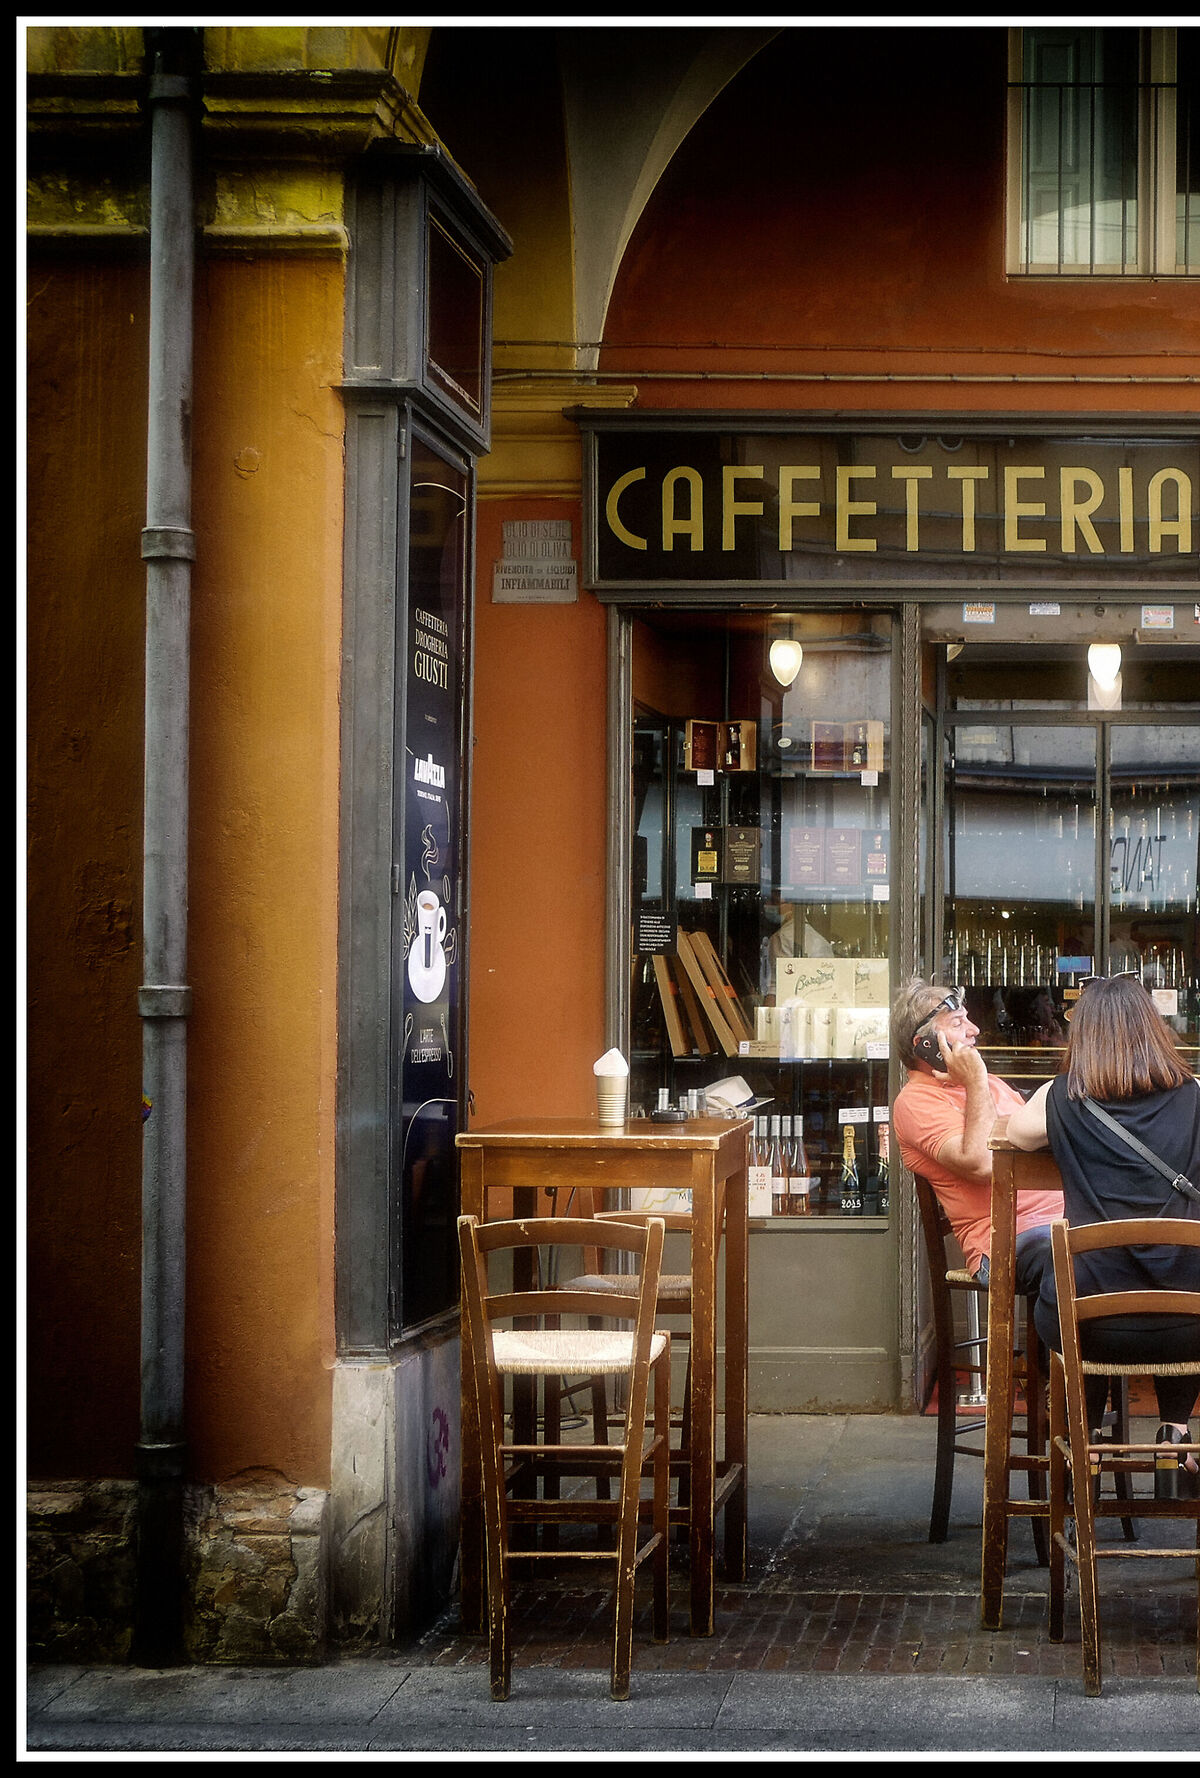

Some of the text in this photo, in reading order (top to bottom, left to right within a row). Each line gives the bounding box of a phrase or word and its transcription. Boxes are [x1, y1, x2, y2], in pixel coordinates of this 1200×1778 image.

[605, 464, 1193, 554] CAFFETTERIA
[541, 541, 568, 557] OLIVA
[501, 578, 570, 590] INFIAMMABILI
[415, 607, 449, 637] CAFFETTERIA
[415, 628, 449, 660] DROGHERIA
[414, 650, 449, 690] GIUSTI
